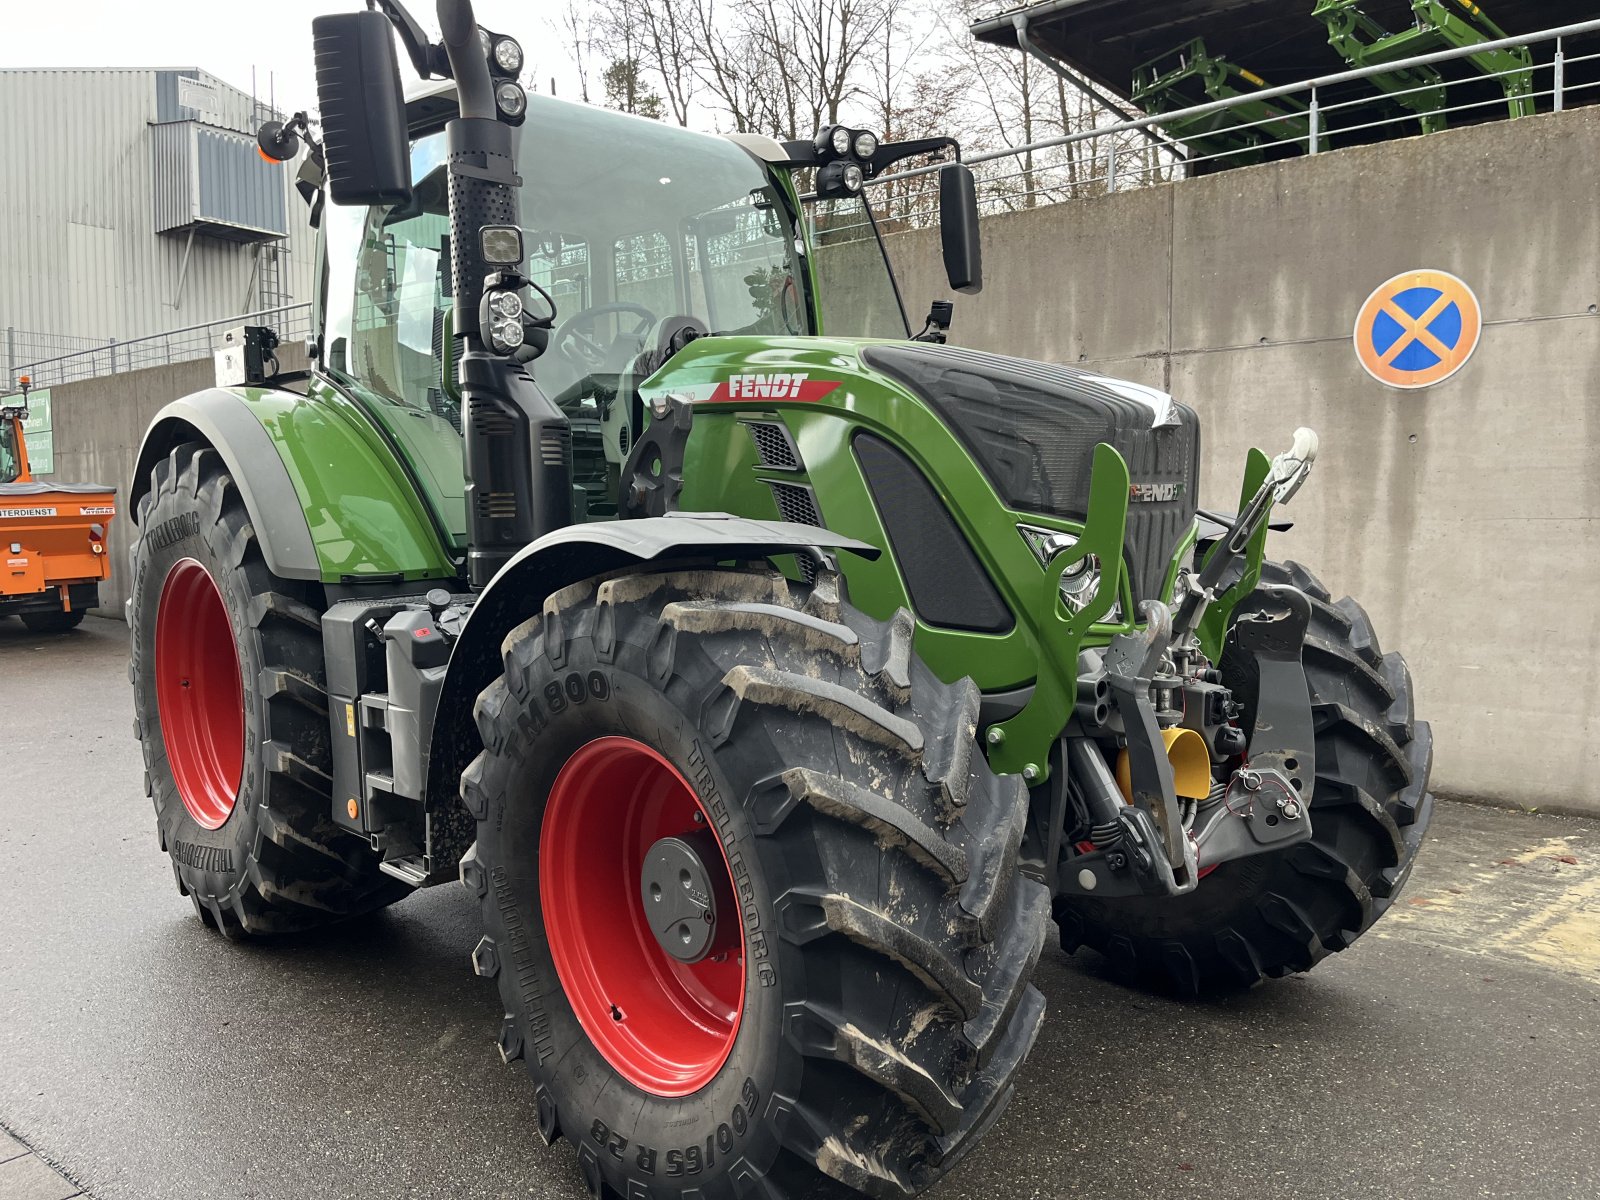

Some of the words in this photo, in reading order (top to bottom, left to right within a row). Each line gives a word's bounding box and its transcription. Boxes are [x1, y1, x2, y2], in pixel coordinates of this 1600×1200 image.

[728, 373, 810, 398] FENDT
[145, 510, 200, 555] TRELLEBORG
[175, 840, 237, 875] TRELLEBORG
[687, 738, 777, 988] TRELLEBORG
[491, 864, 554, 1068] TRELLEBORG
[590, 1118, 629, 1163] 28
[665, 1076, 760, 1178] 600/65
[636, 1142, 658, 1177] R
